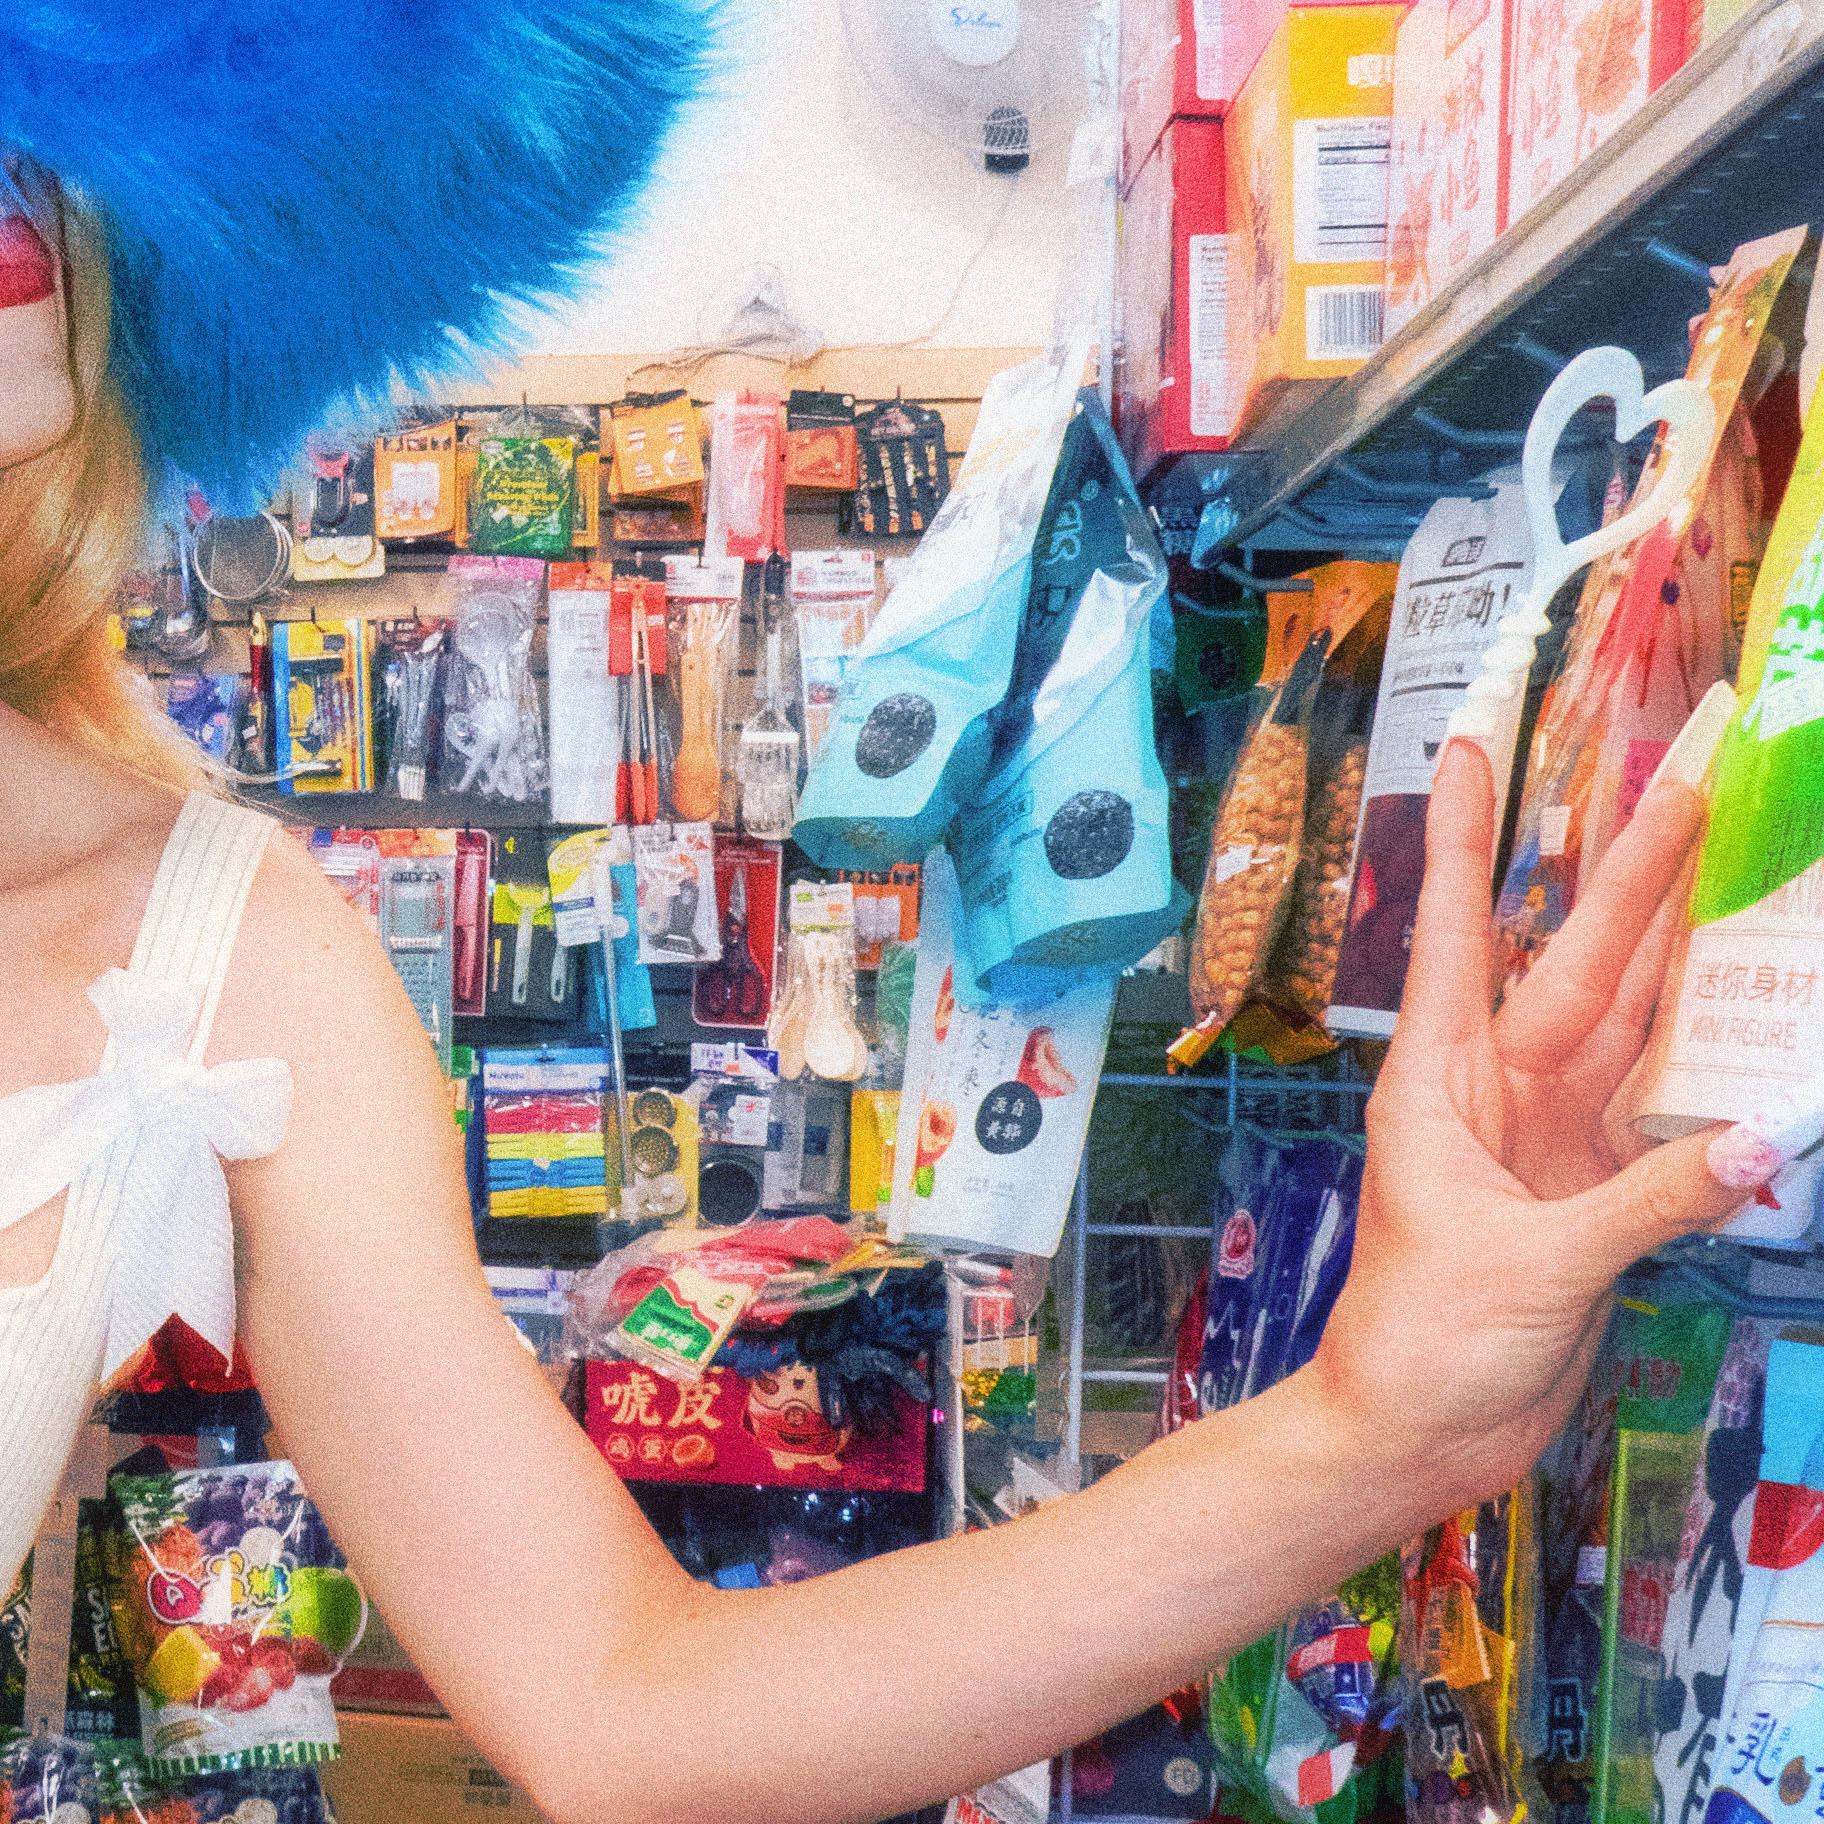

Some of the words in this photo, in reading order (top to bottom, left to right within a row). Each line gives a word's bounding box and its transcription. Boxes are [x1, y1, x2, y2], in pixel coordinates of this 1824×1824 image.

[1696, 960, 1820, 1007] 迷你身材
[1728, 1016, 1798, 1052] FIGURE
